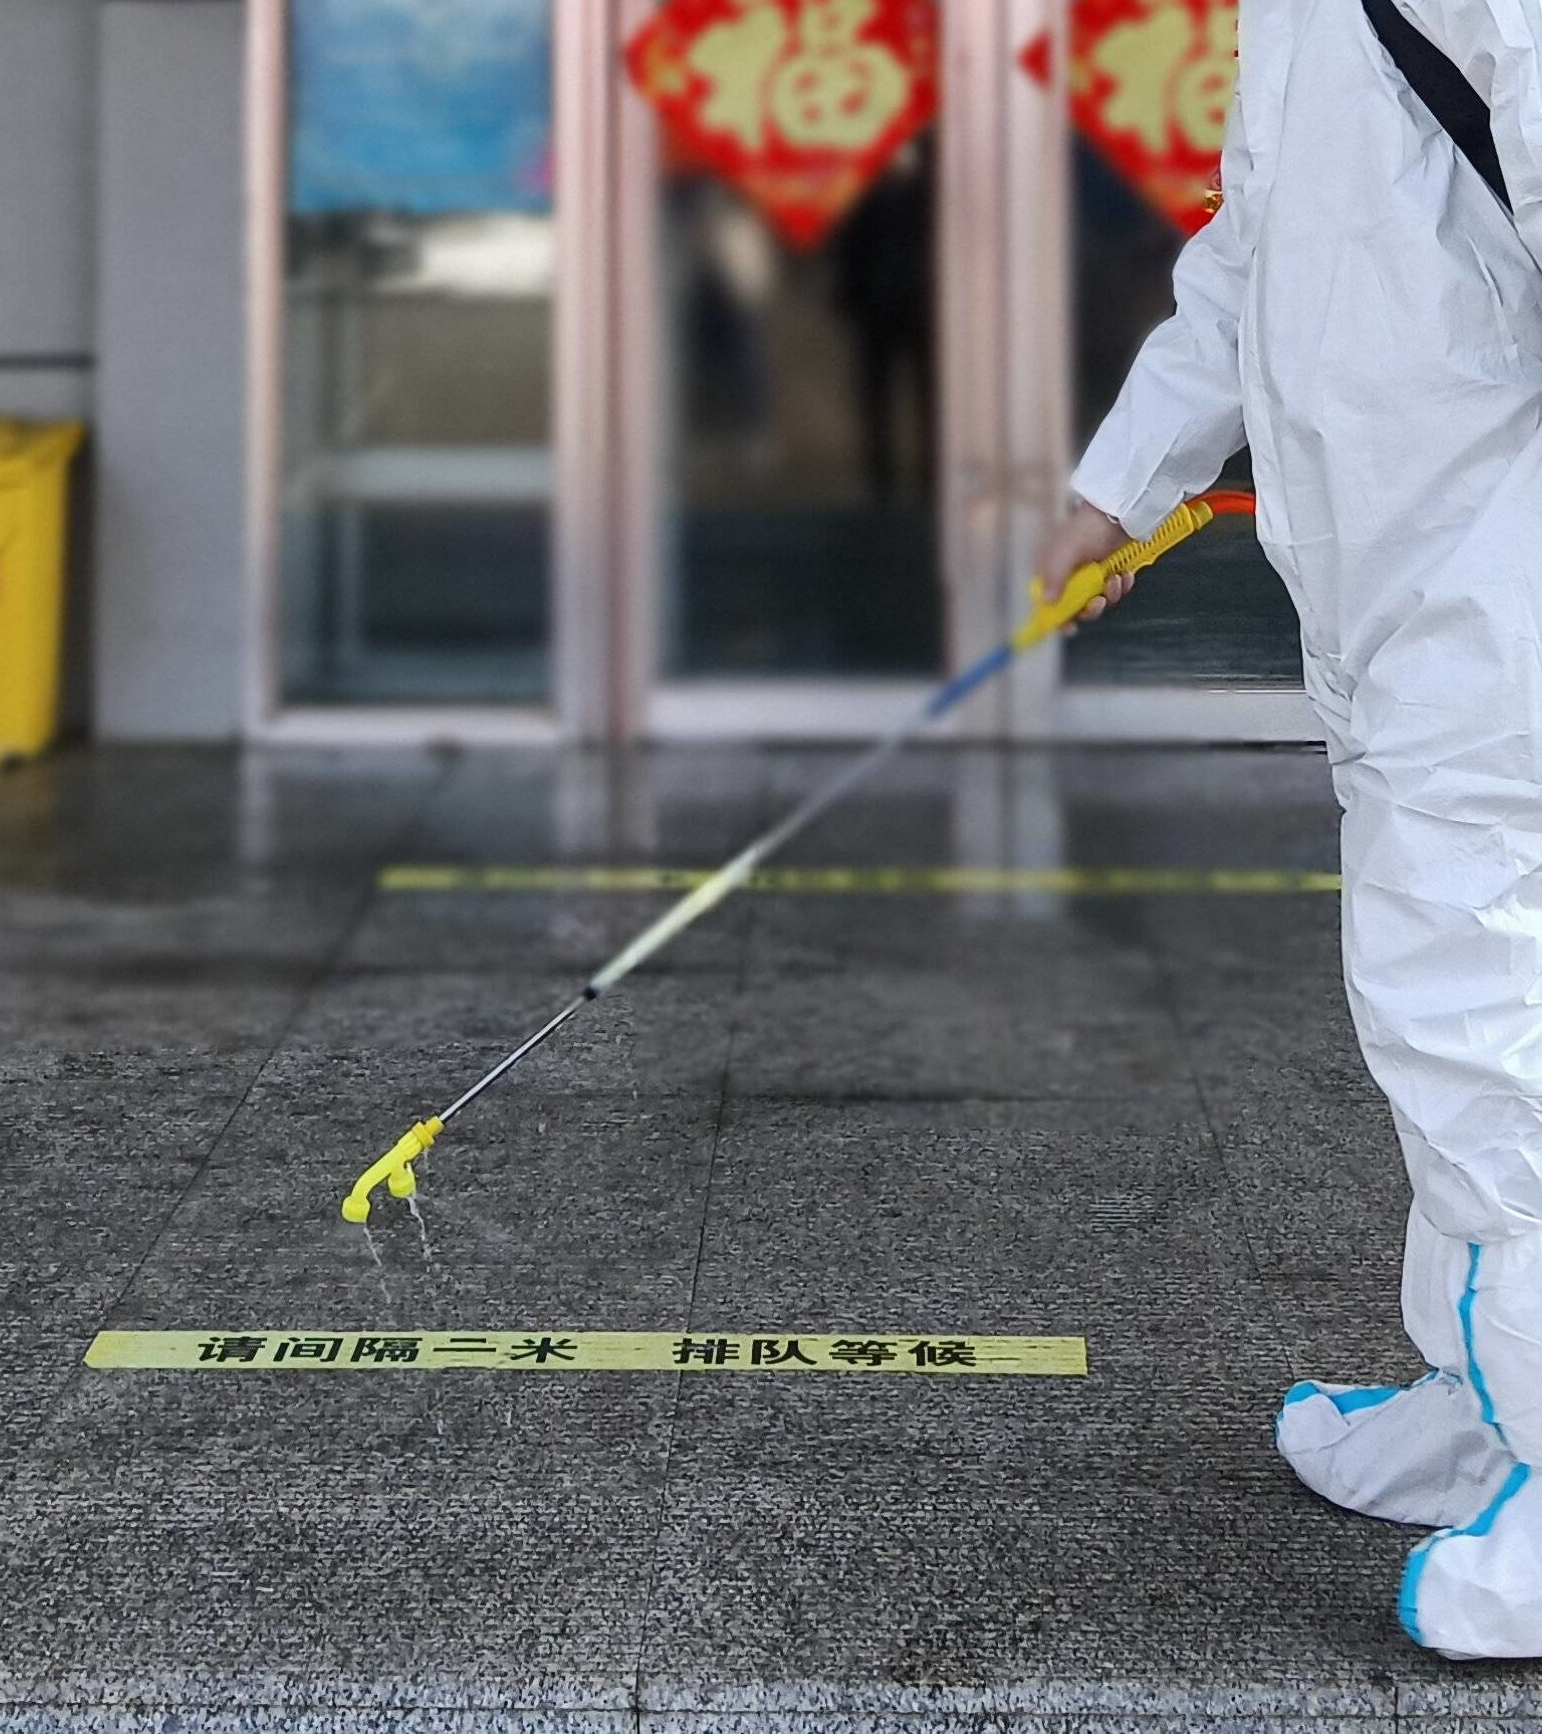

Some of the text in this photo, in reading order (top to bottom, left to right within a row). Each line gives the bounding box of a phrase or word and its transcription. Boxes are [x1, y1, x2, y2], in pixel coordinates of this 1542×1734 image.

[197, 1337, 976, 1367] 请间隔二米 排队等候
